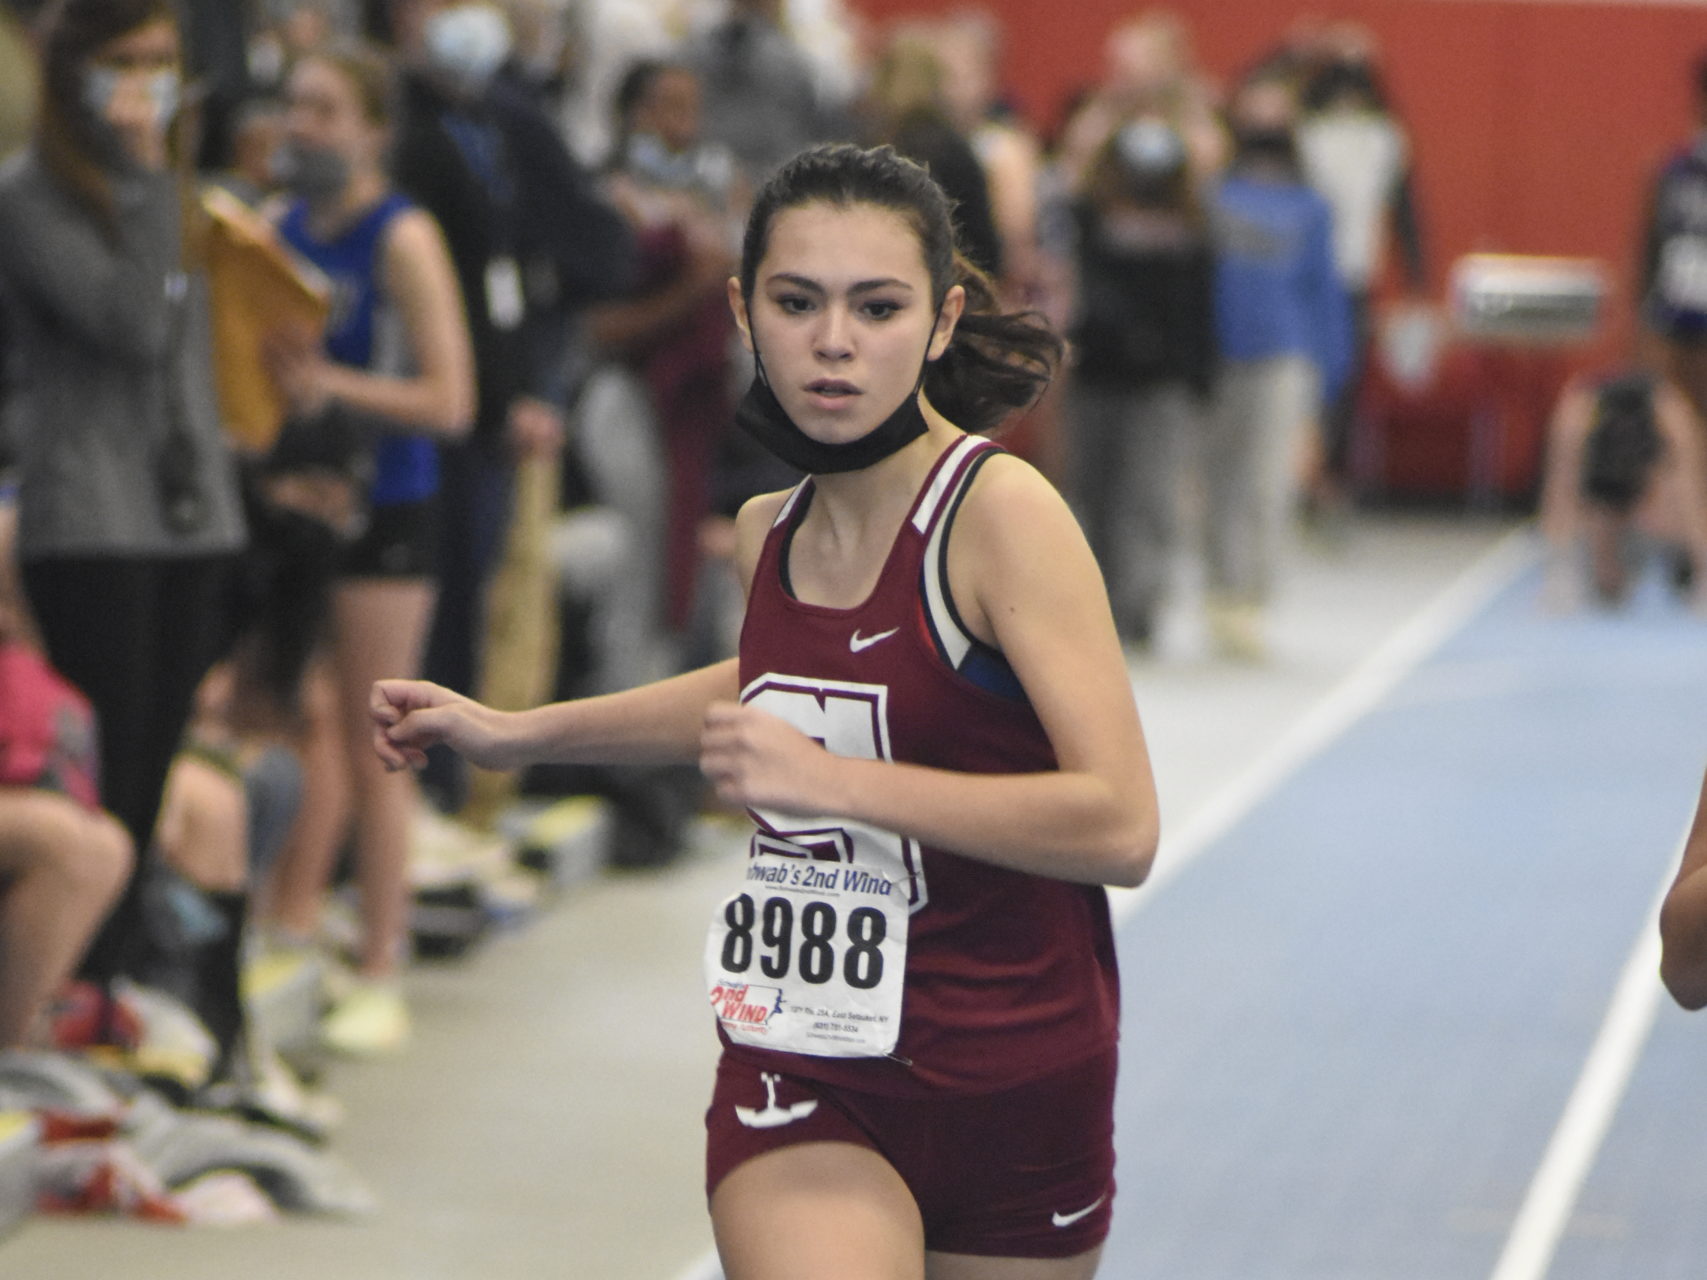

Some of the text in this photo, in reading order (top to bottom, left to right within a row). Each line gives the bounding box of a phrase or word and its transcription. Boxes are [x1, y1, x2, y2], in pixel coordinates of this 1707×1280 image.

[802, 866, 840, 890] 2nd
[720, 893, 887, 990] 8988
[722, 1001, 768, 1024] WIND
